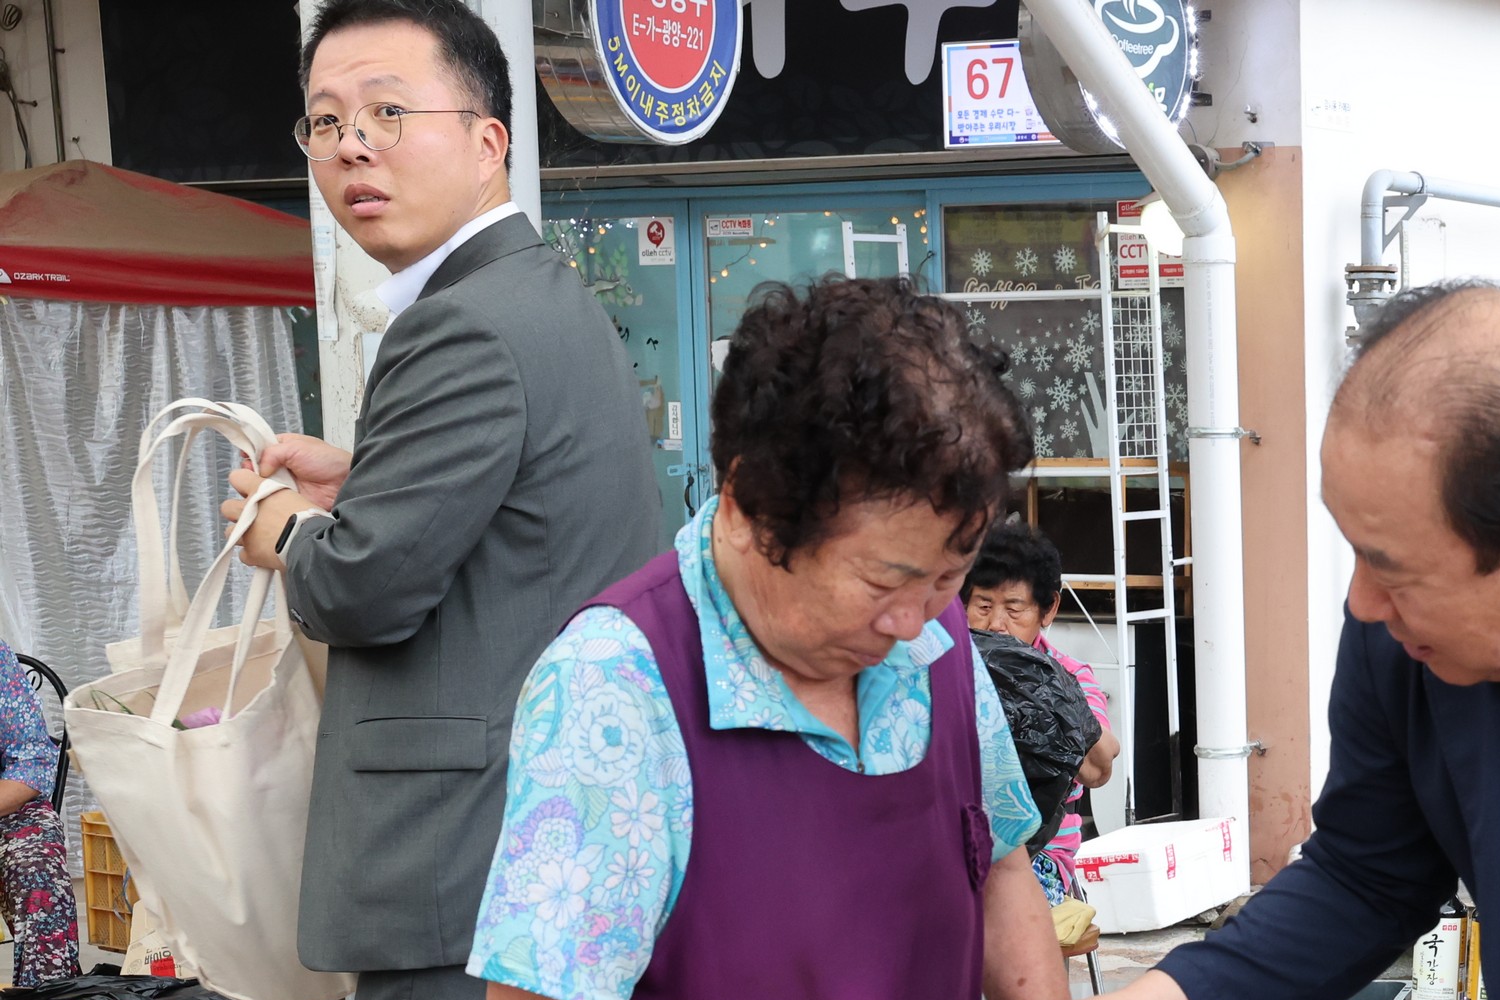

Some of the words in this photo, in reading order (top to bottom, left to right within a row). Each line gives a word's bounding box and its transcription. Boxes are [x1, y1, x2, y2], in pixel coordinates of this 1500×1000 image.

[632, 13, 705, 51] E-가-광양-221
[966, 57, 1014, 100] 67
[721, 220, 737, 229] CCTV
[642, 248, 658, 256] olleh
